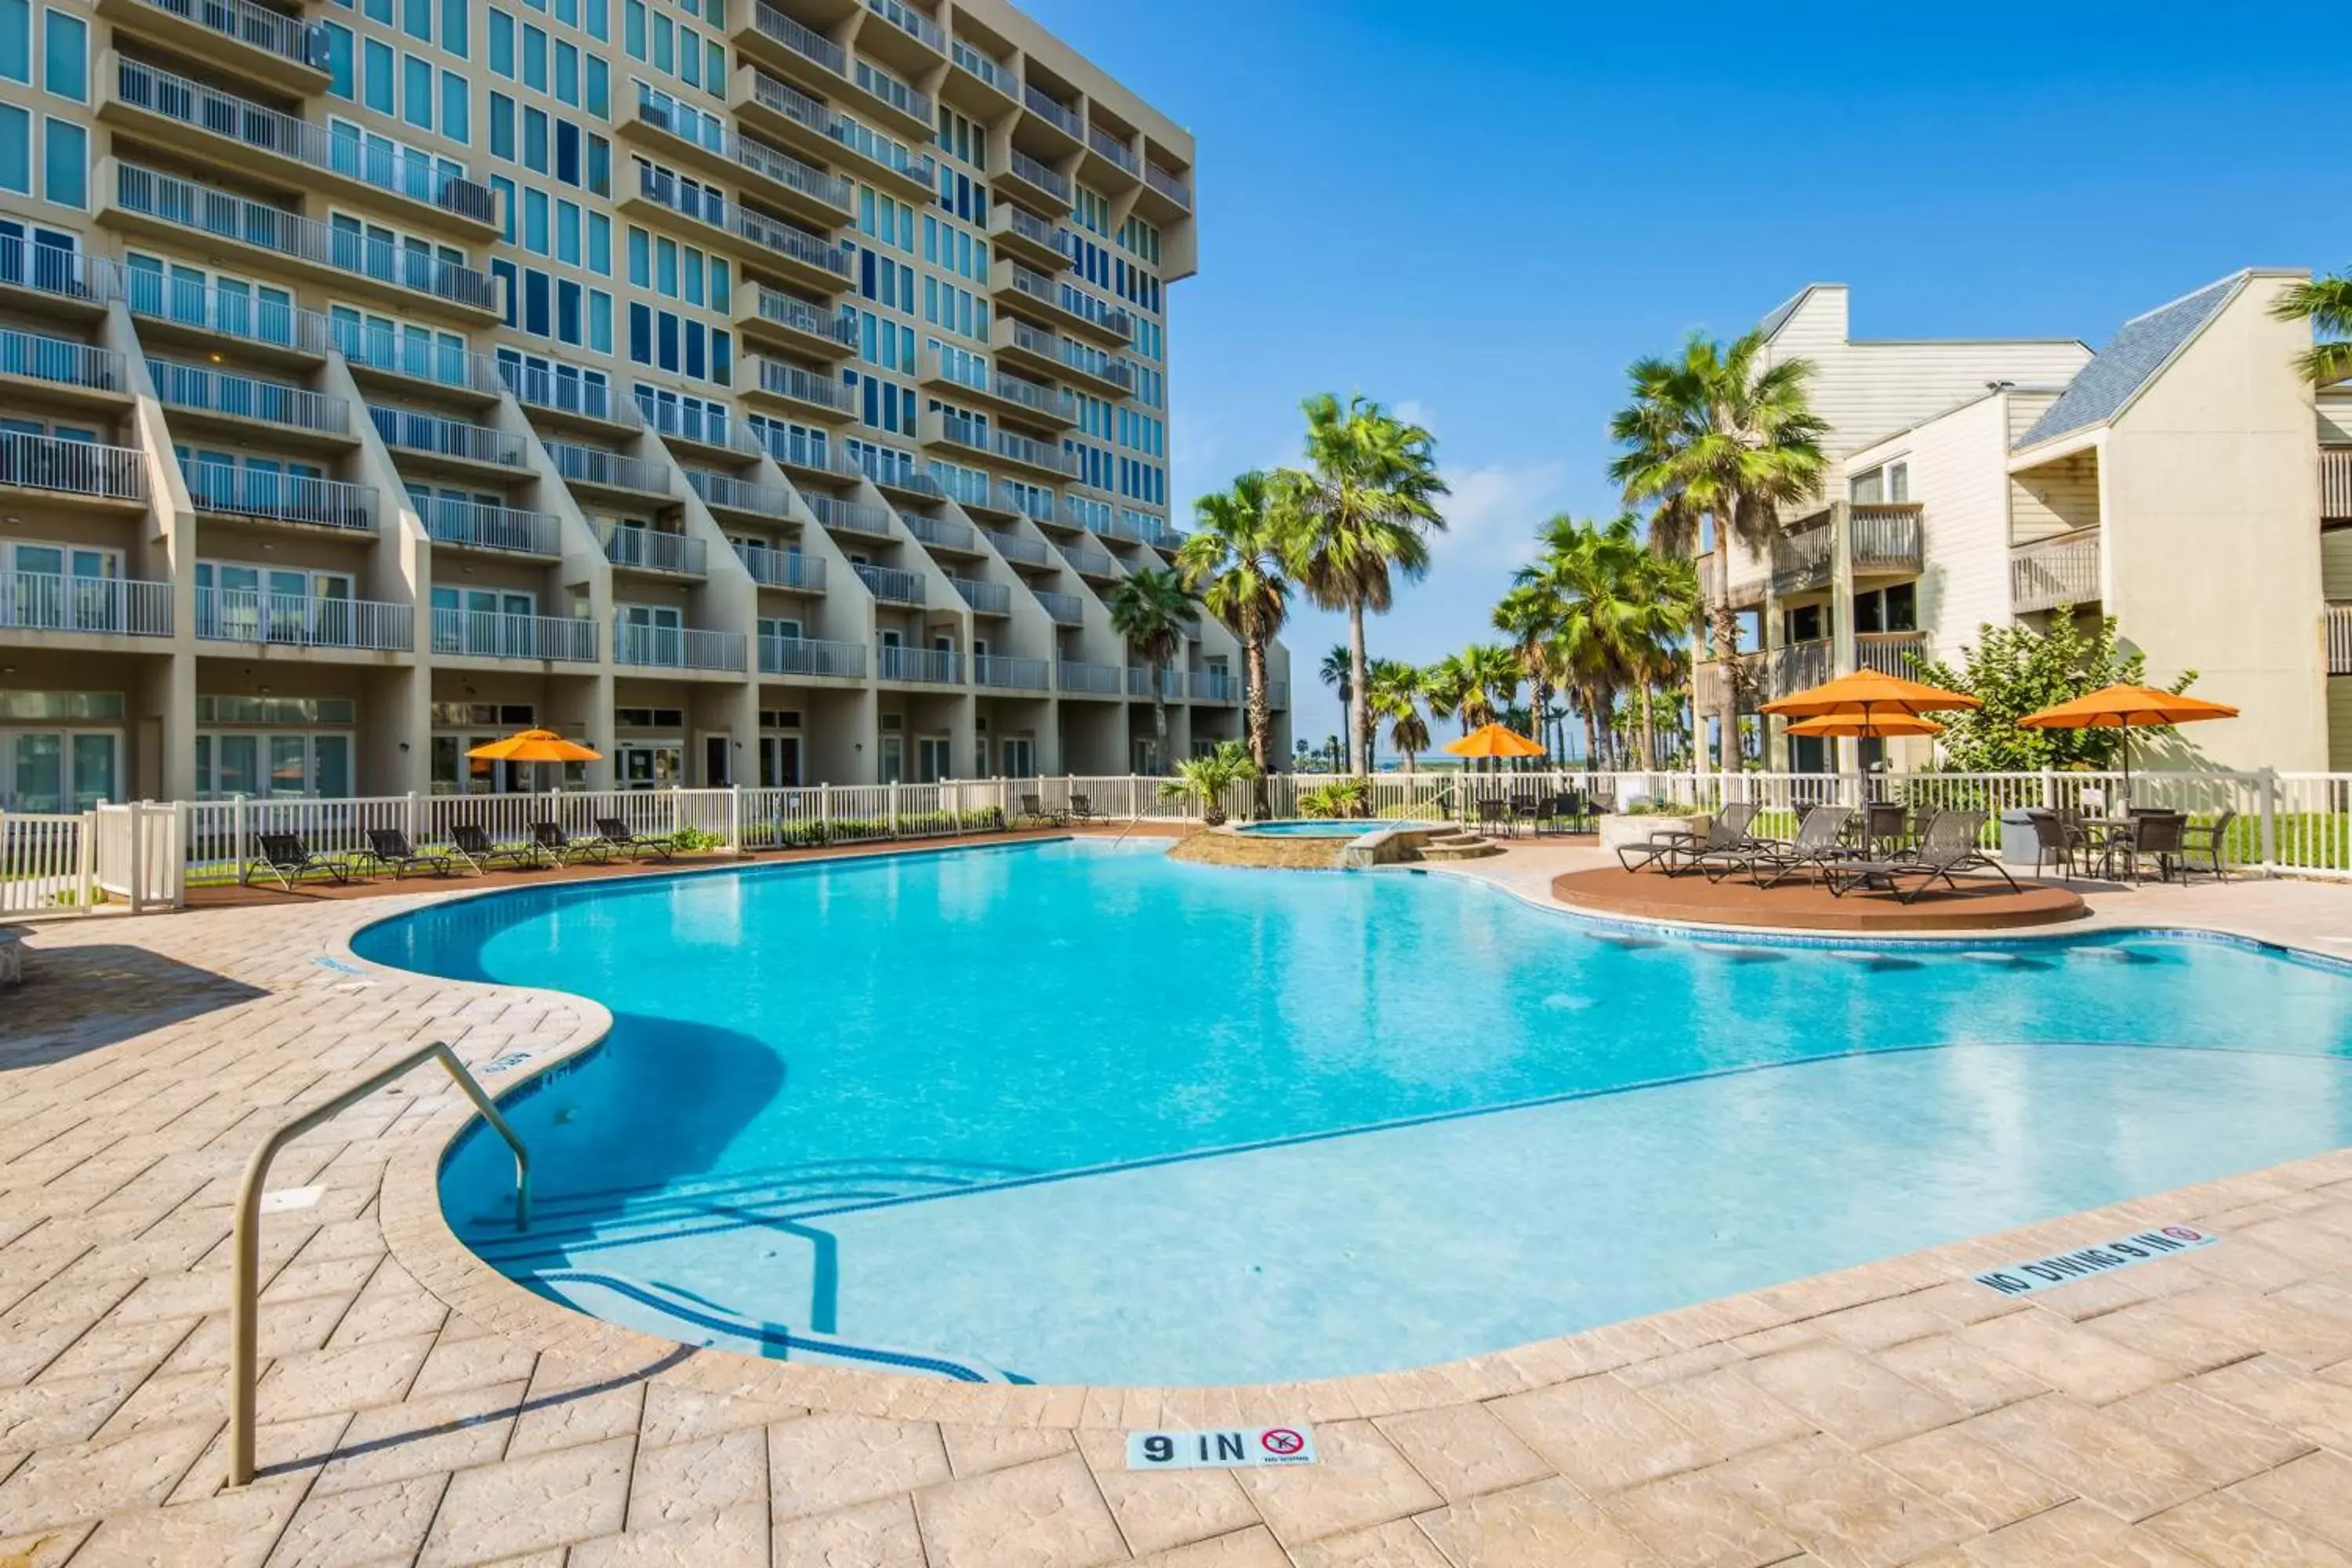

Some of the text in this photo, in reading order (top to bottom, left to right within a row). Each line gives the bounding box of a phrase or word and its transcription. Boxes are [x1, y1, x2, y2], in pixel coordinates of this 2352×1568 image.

[1976, 1274, 2031, 1294] NO
[2020, 1249, 2127, 1281] DIVING
[2109, 1243, 2151, 1257] 9
[2131, 1233, 2186, 1252] IN
[1144, 1432, 1245, 1462] 9 IN
